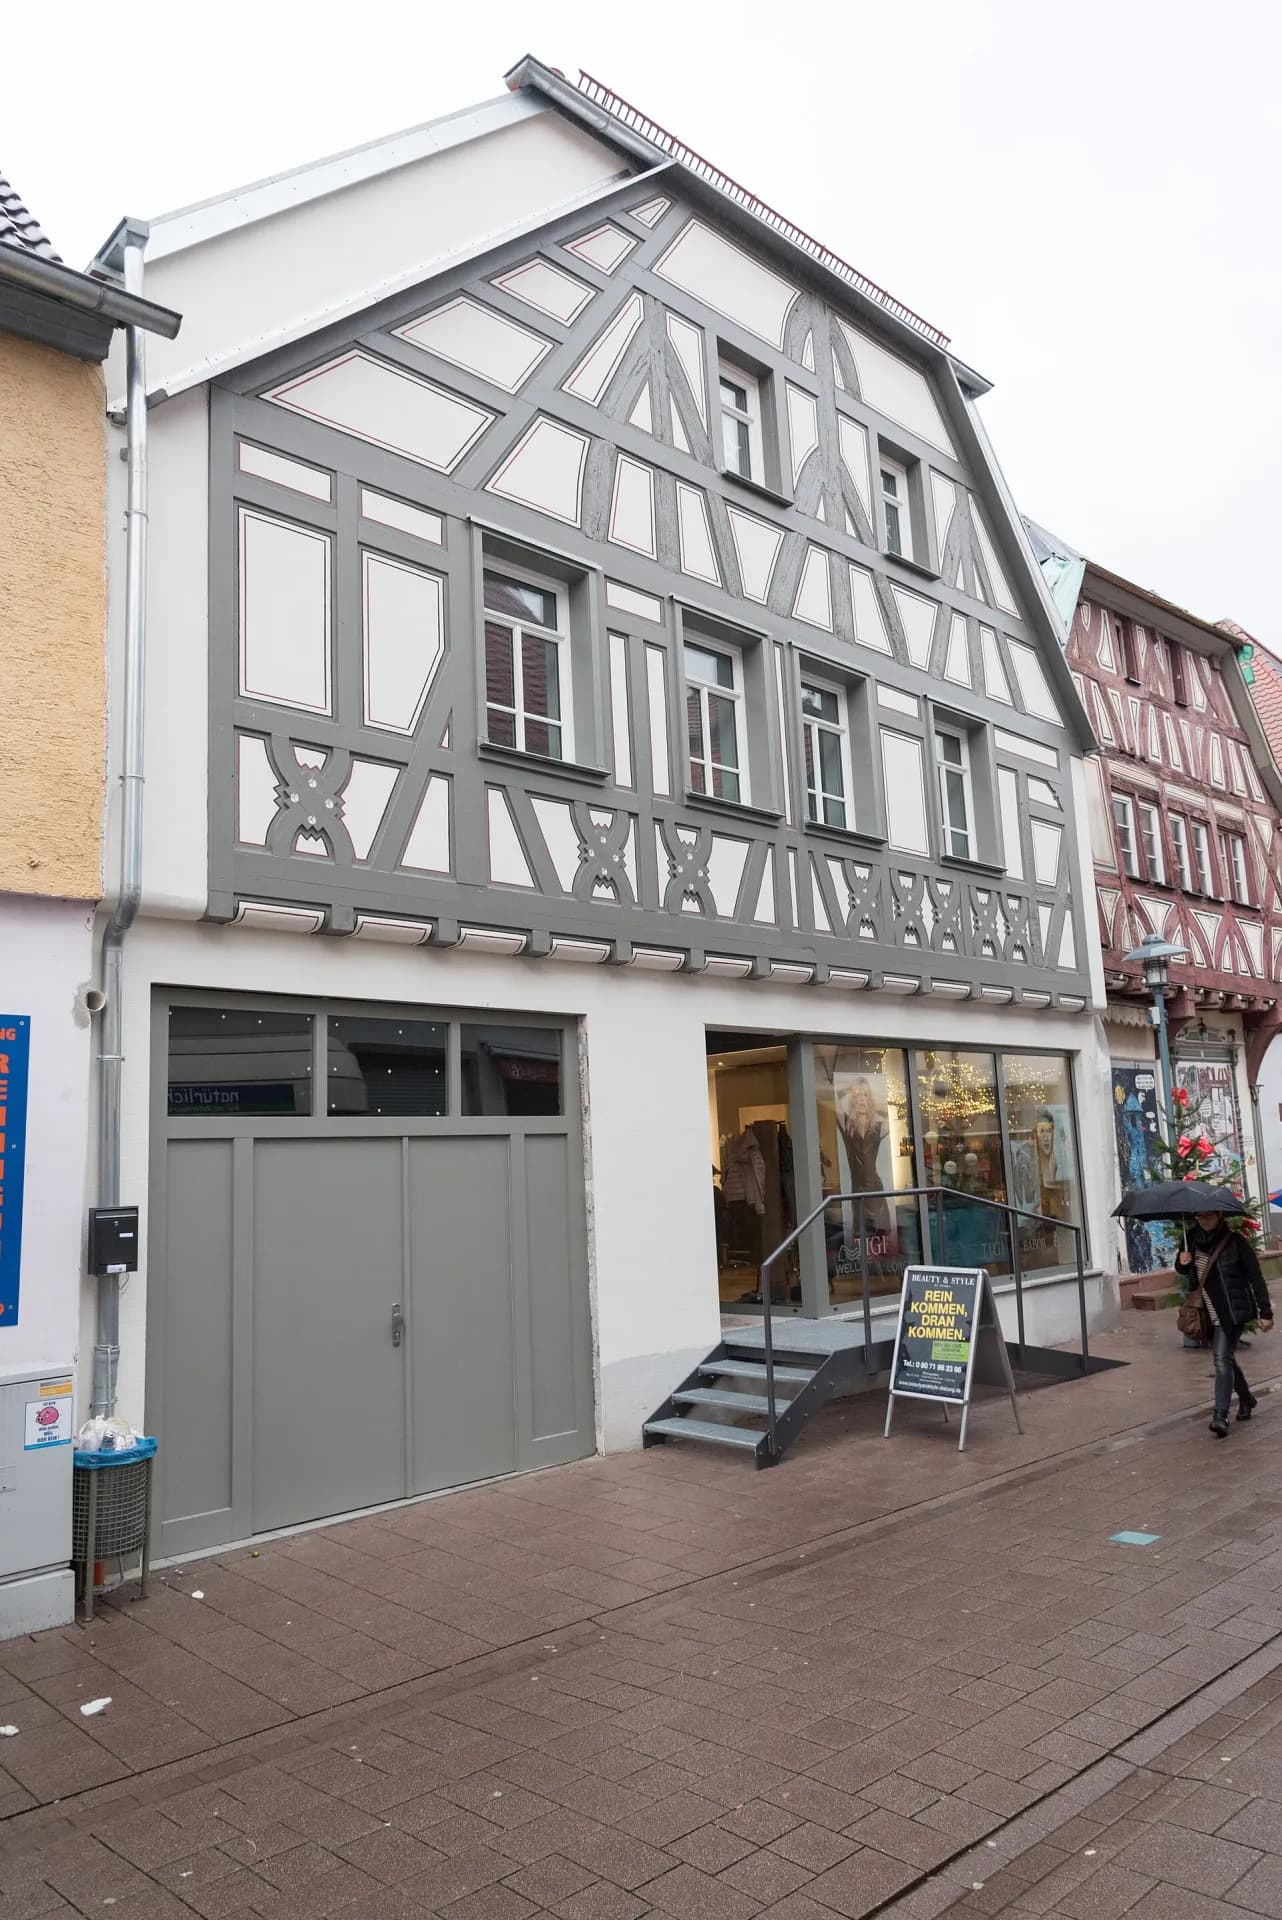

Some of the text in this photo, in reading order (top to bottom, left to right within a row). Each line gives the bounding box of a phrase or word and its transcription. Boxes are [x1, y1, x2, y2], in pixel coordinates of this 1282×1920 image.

[912, 1274, 941, 1284] BEAUTY
[943, 1276, 948, 1284] &
[951, 1277, 976, 1286] STYLE
[925, 1290, 953, 1302] REIN
[910, 1302, 968, 1317] KOMMEN,
[921, 1315, 955, 1327] DRAN
[908, 1327, 966, 1340] KOMMEN.
